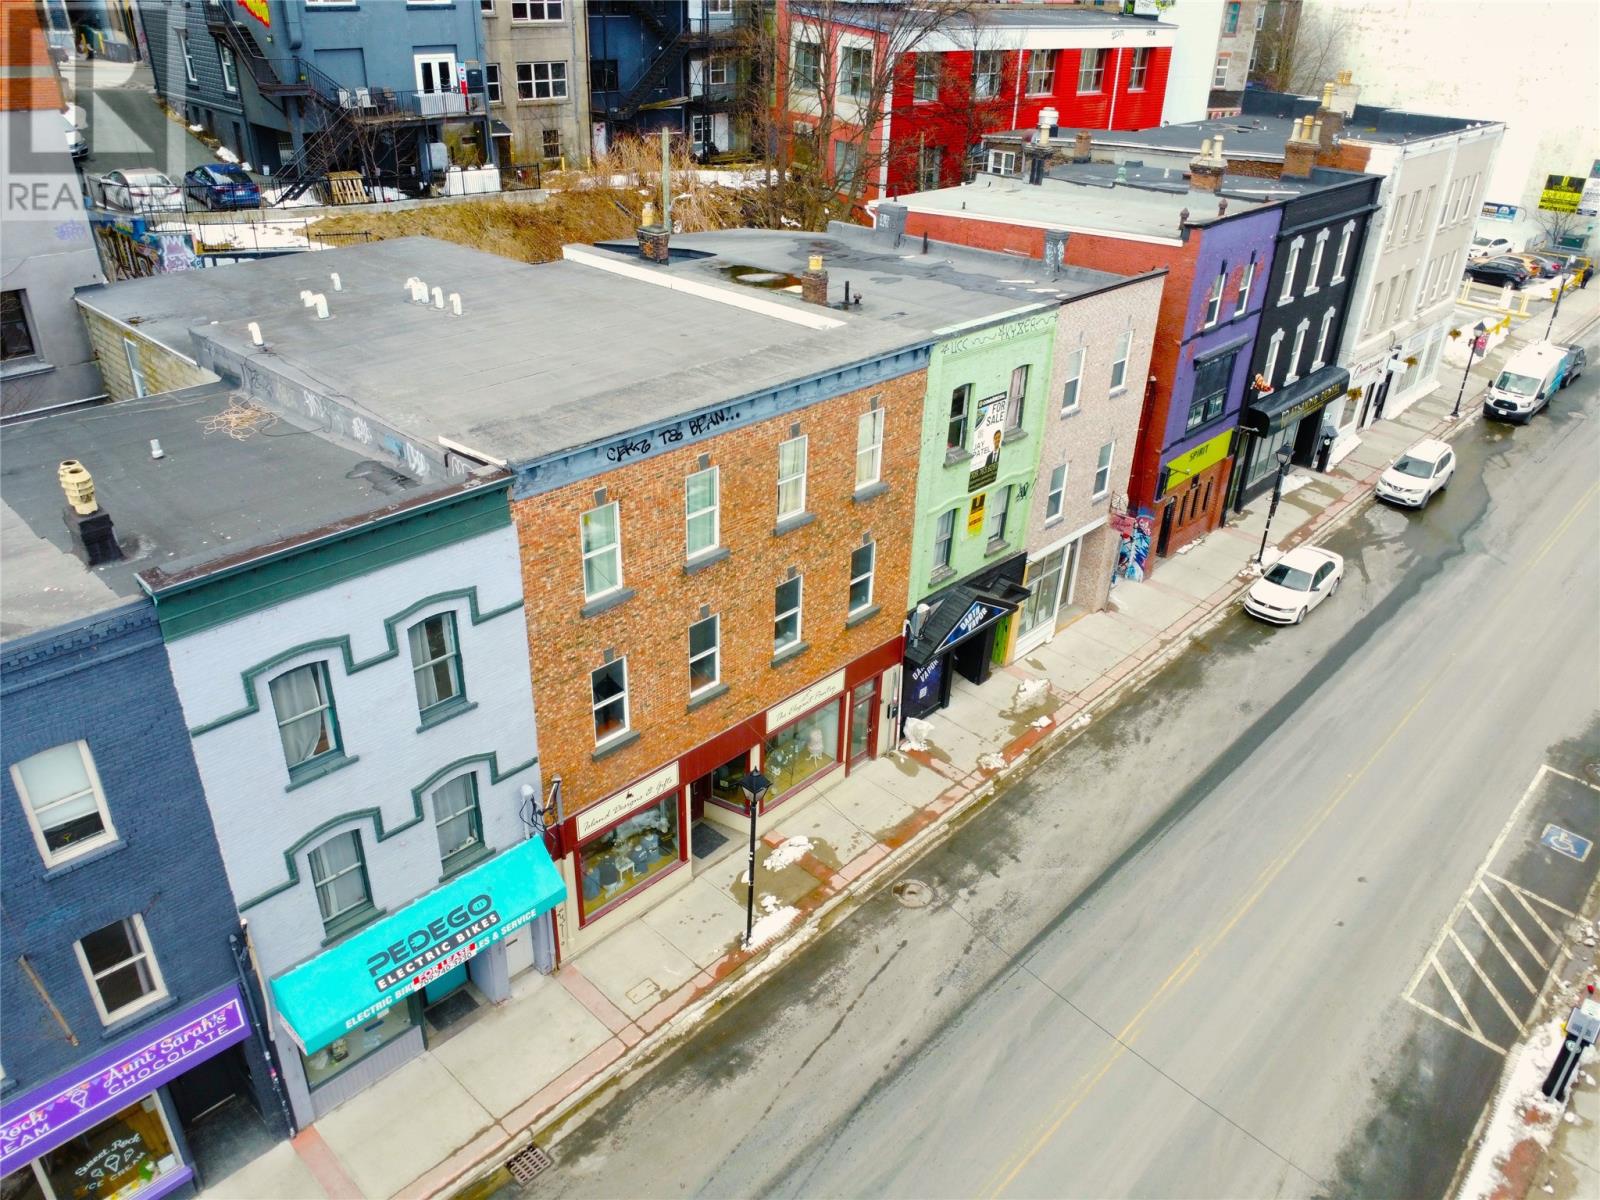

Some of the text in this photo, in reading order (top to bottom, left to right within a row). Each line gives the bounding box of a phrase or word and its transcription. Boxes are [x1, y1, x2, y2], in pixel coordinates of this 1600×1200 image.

[986, 411, 1005, 427] SALE
[992, 401, 1006, 414] FOR
[968, 608, 988, 631] VAPOR
[366, 894, 492, 977] PEDEGO
[377, 914, 498, 990] ELECTRIC BIKES
[345, 996, 393, 1030] ELECTRIC
[492, 931, 499, 940] &
[501, 909, 536, 936] SERVICE
[419, 946, 471, 982] FOR LEASE
[104, 1013, 226, 1088] Aunt Sarah's
[108, 1027, 229, 1095] CHOCOLATE
[75, 1133, 140, 1176] Sweet Rock
